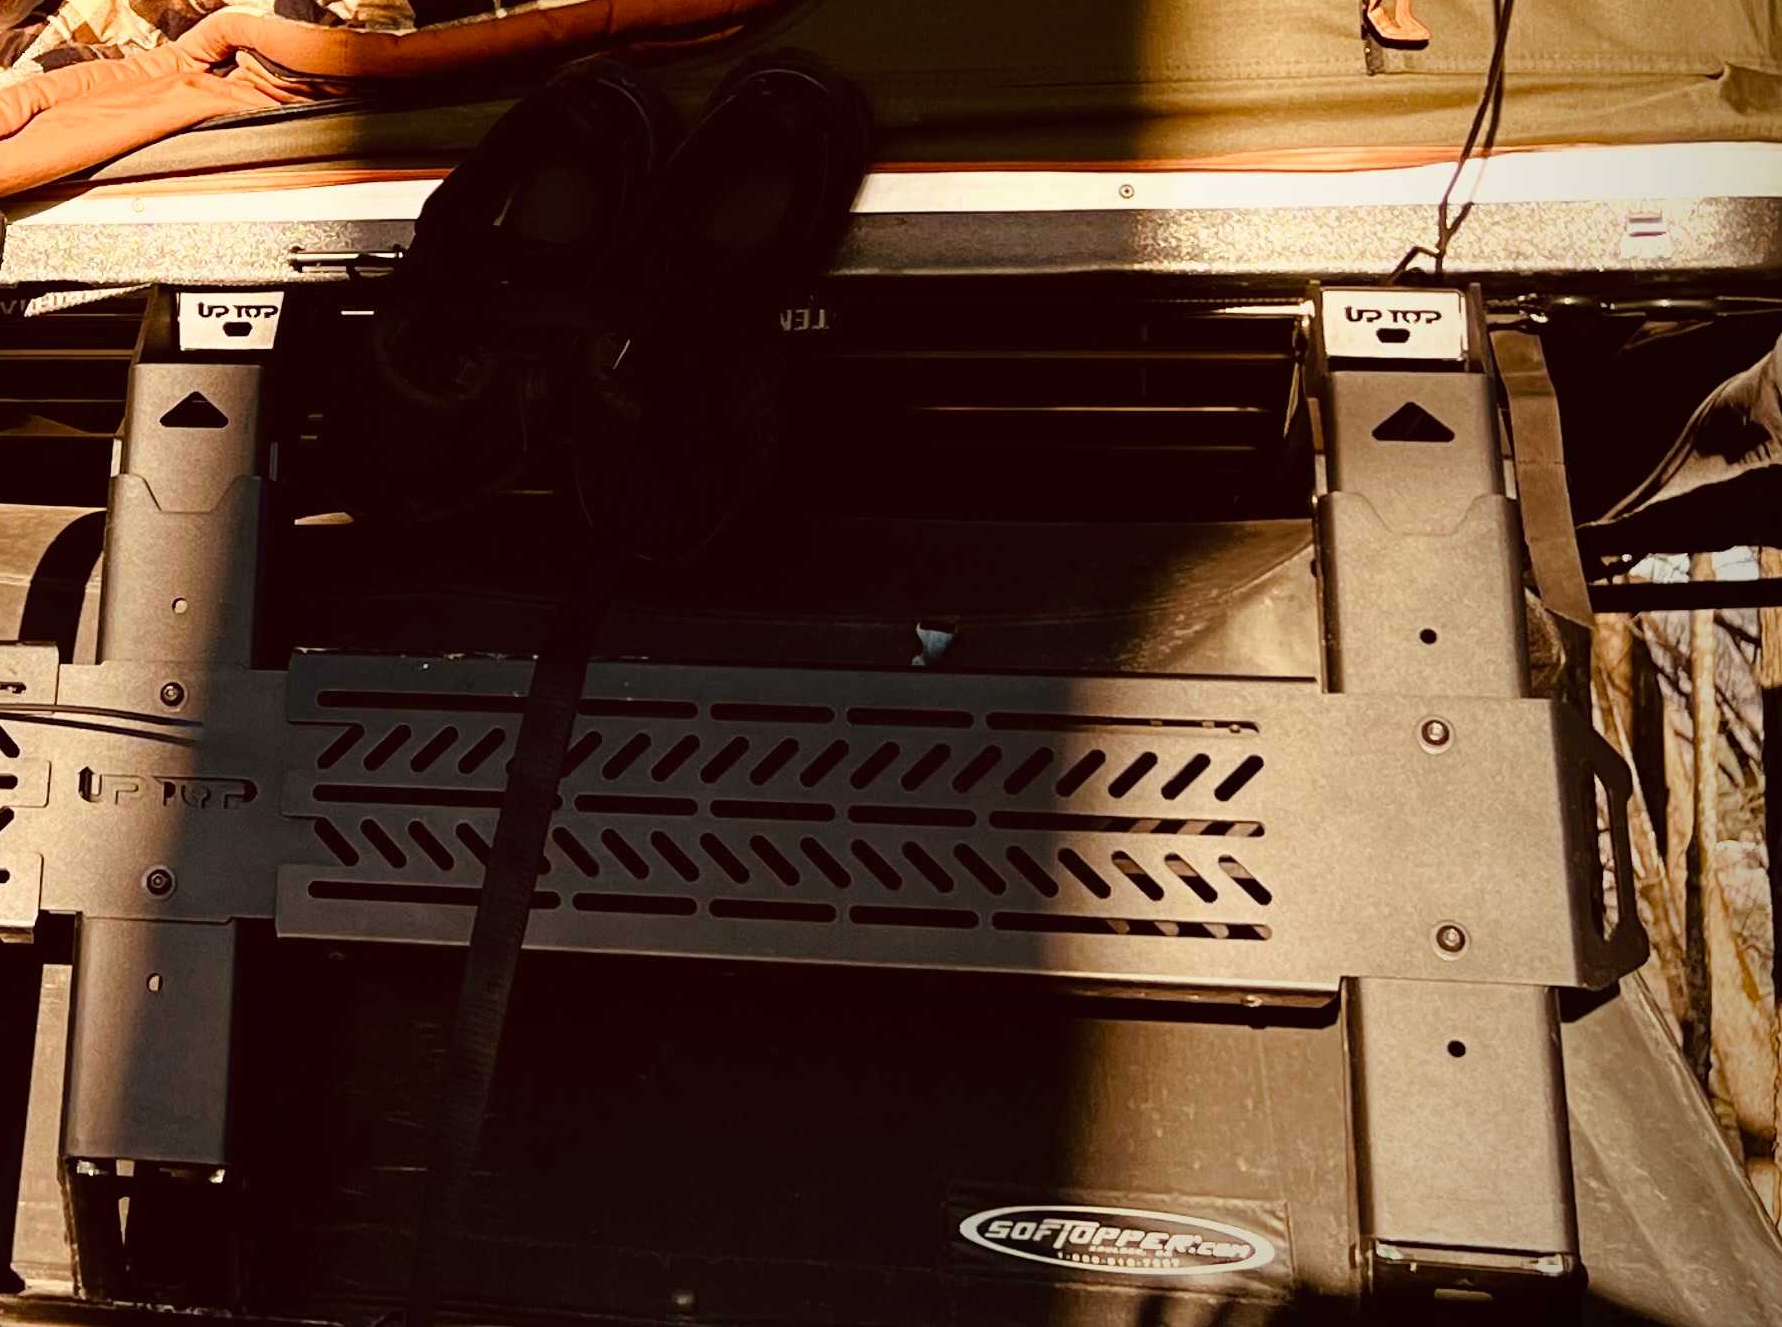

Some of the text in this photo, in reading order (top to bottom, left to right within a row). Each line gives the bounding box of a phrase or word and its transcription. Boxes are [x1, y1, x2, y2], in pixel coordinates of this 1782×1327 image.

[197, 301, 279, 318] UP TOP
[1345, 306, 1442, 324] UP TOP
[78, 765, 259, 810] UP TOP
